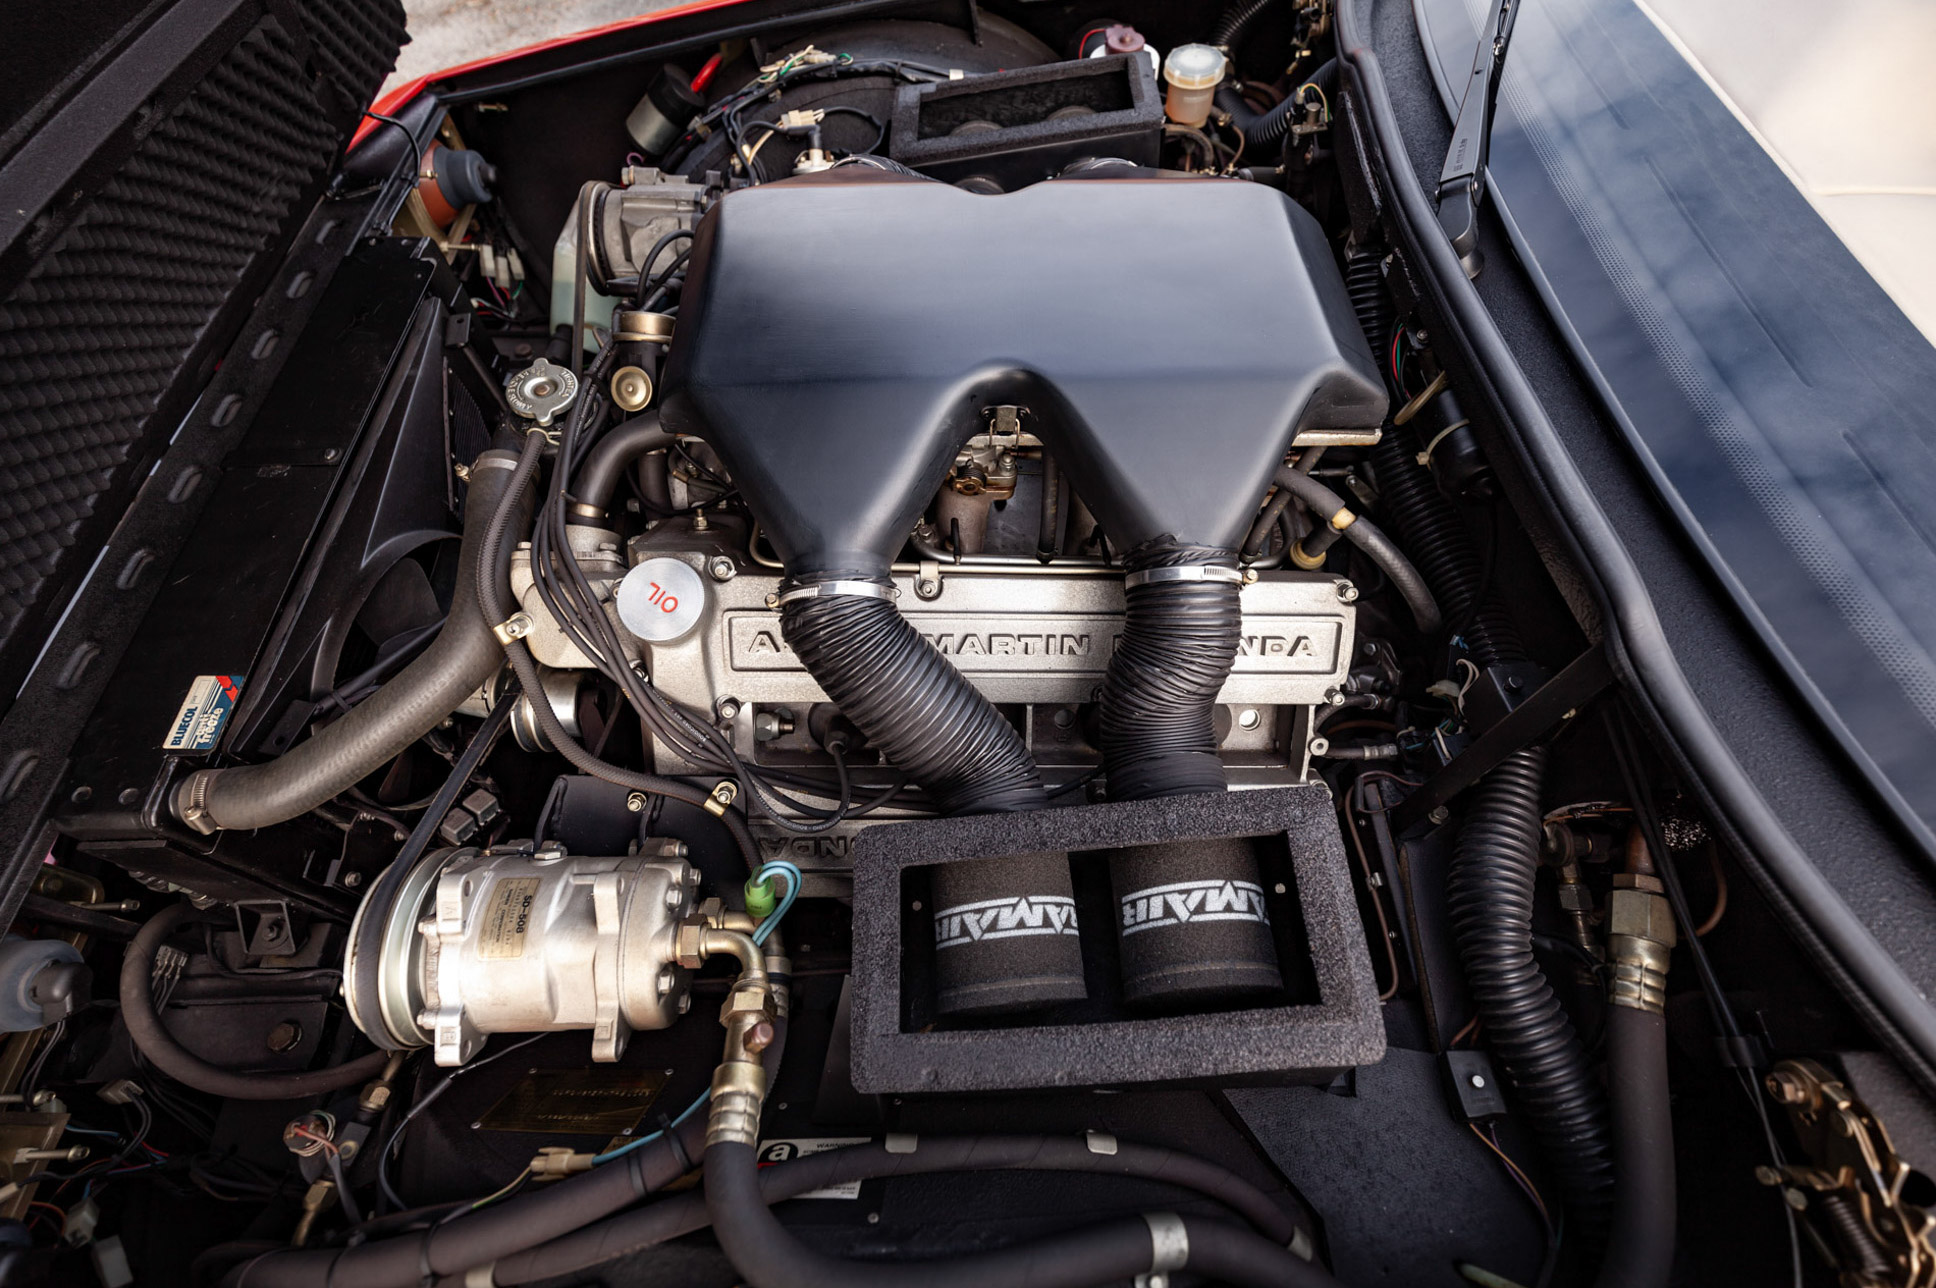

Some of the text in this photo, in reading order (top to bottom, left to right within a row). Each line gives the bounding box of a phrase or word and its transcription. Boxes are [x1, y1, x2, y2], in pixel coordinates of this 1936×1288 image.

[648, 581, 679, 613] OIL
[926, 632, 1090, 656] MARTIN
[171, 706, 199, 746] BLUECOL
[198, 708, 223, 744] freeze
[515, 895, 532, 933] SD-508
[1121, 881, 1268, 927] AMAIR
